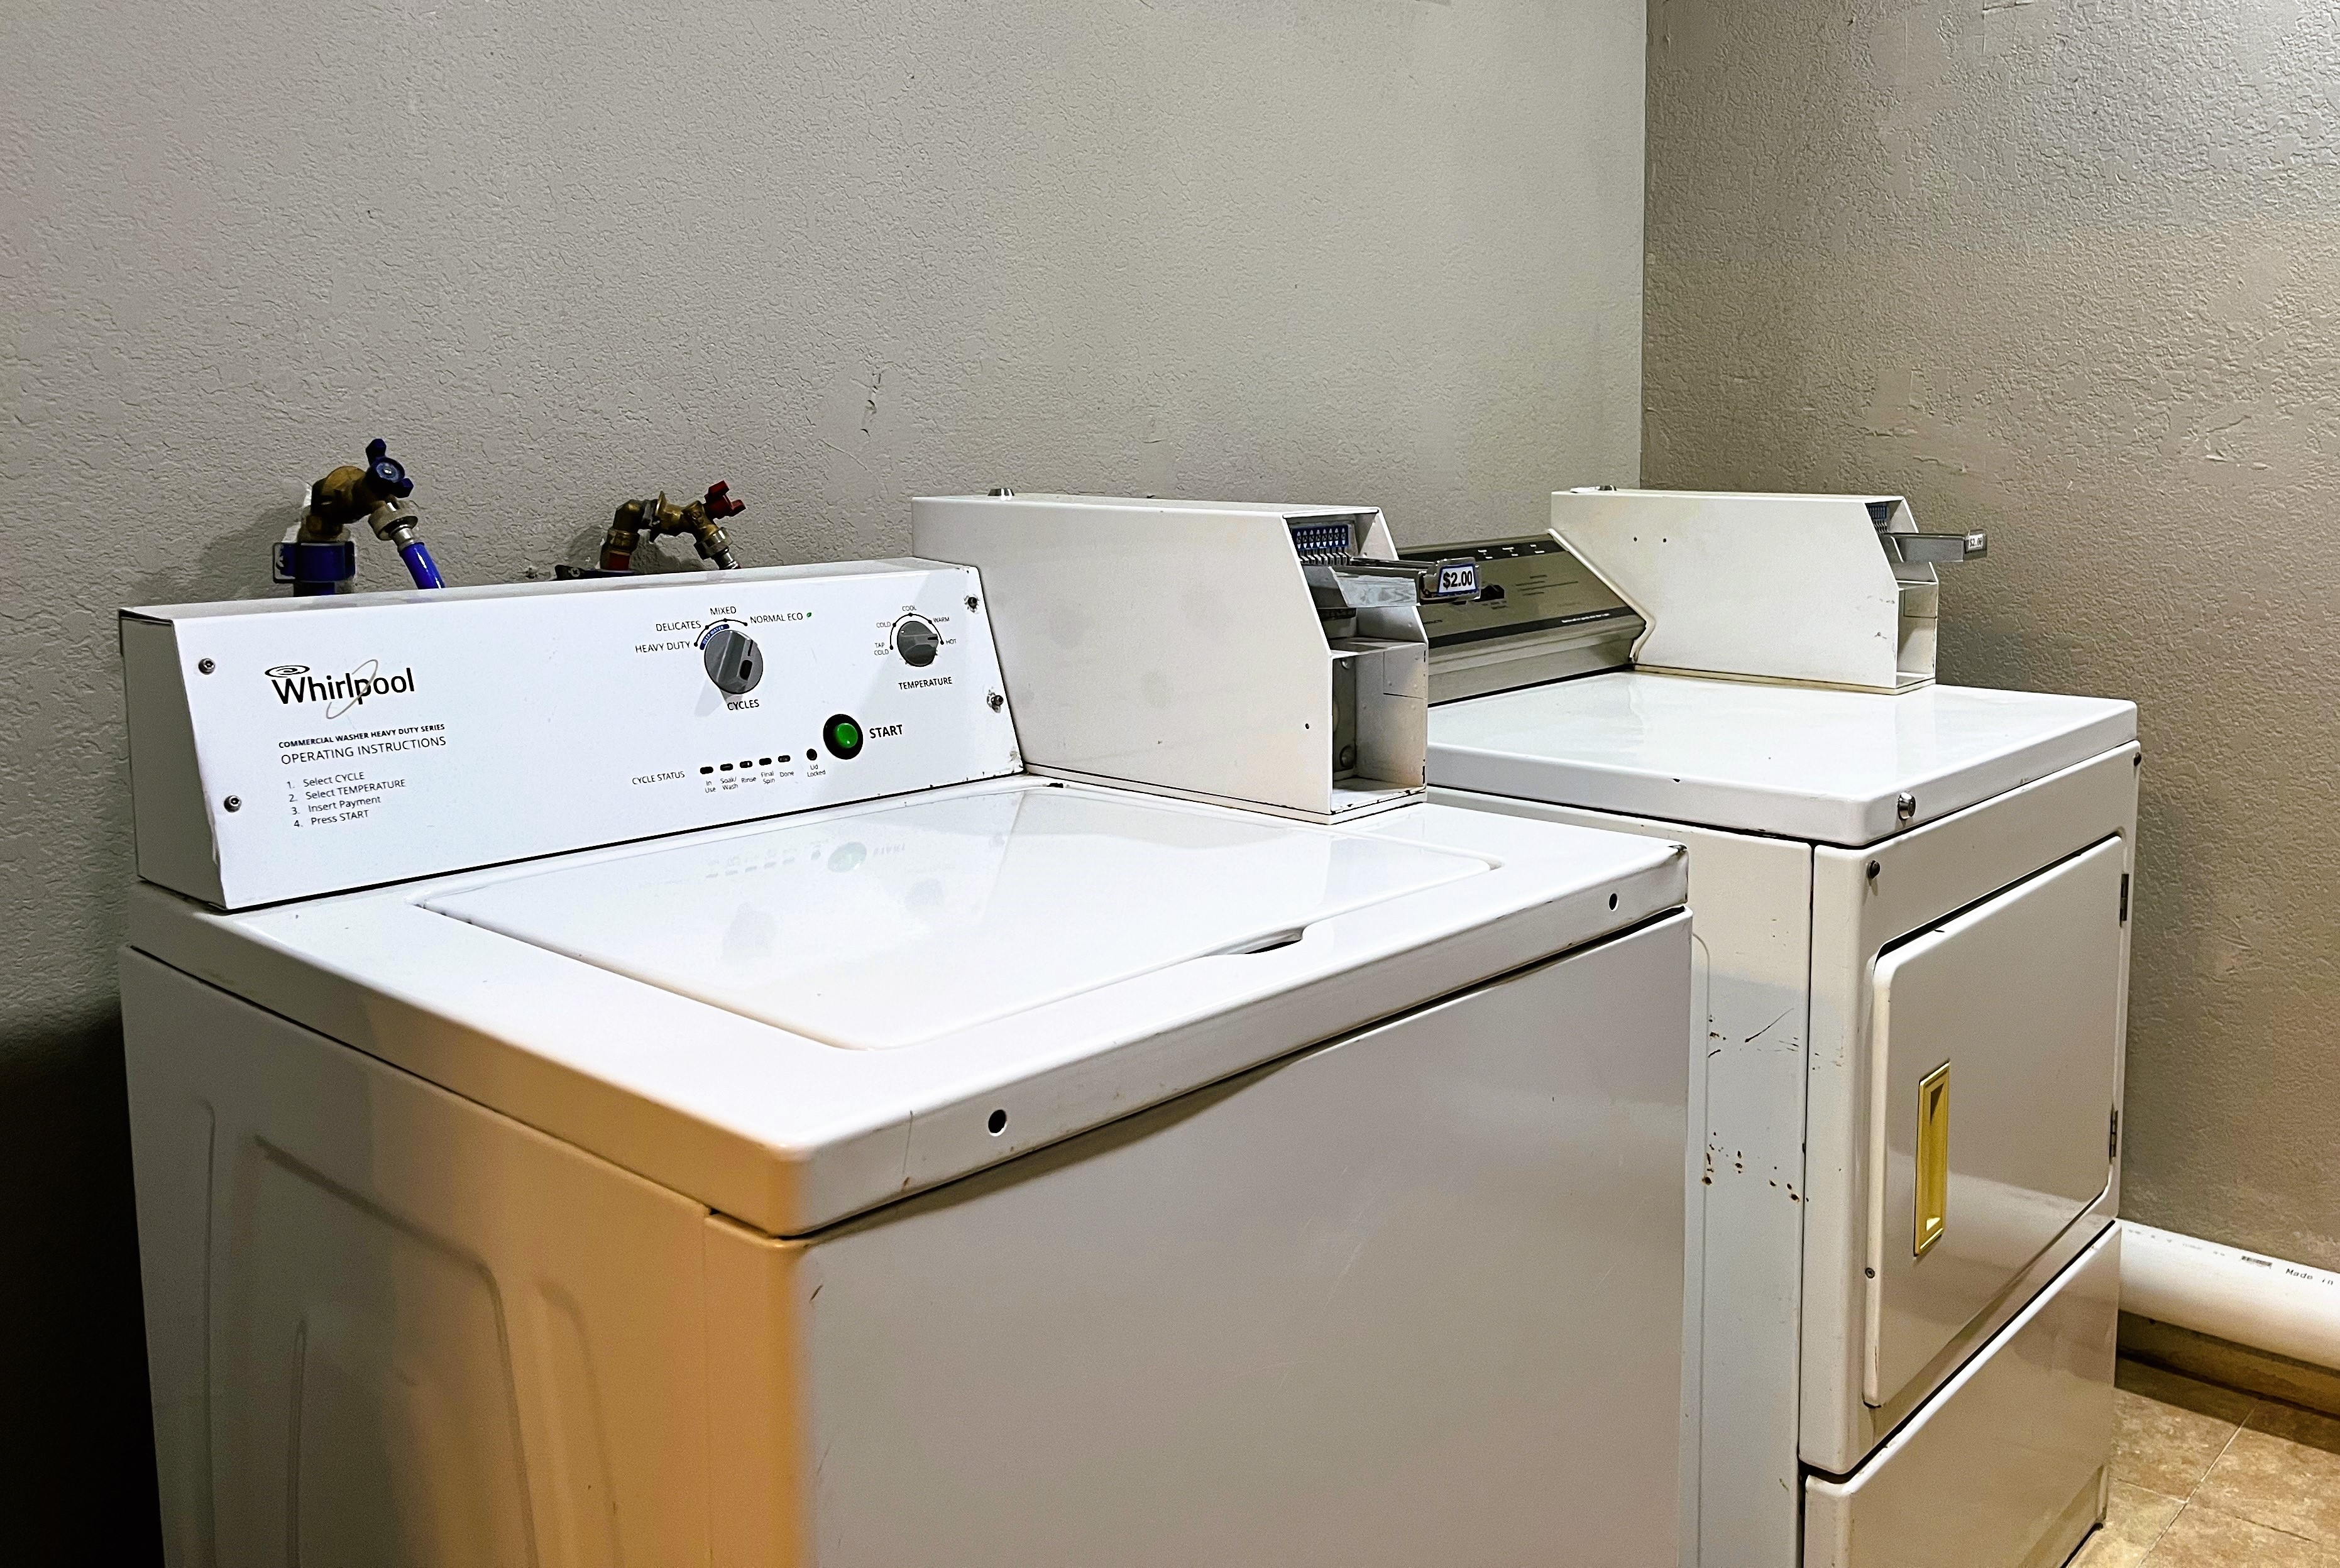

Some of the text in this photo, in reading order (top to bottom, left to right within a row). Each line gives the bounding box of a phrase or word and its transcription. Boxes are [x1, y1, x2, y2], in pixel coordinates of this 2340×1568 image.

[1442, 570, 1473, 589] $2.00
[710, 606, 736, 615] MIXED
[750, 612, 803, 624] NORMAL ECO
[656, 621, 701, 632] DELICATES
[635, 641, 690, 653] HEAVY DUTY
[272, 667, 415, 705] Whirlpool
[898, 676, 953, 690] TEMPERATURE
[727, 699, 760, 711] CYCLES
[278, 724, 445, 748] COMMERCIAL WASHER HEAVY DUTY SERIES
[869, 725, 903, 738] START
[281, 736, 446, 765] OPERATING INSTRUCTIONS
[287, 772, 365, 789] 1. Select CYCLE
[632, 770, 685, 785] CYCLE STATUS
[288, 779, 407, 803] 2. Select TEMPERATURE
[292, 796, 382, 815] 3. Insert Payment
[294, 809, 369, 828] 4. Press START
[2285, 1268, 2313, 1280] Made
